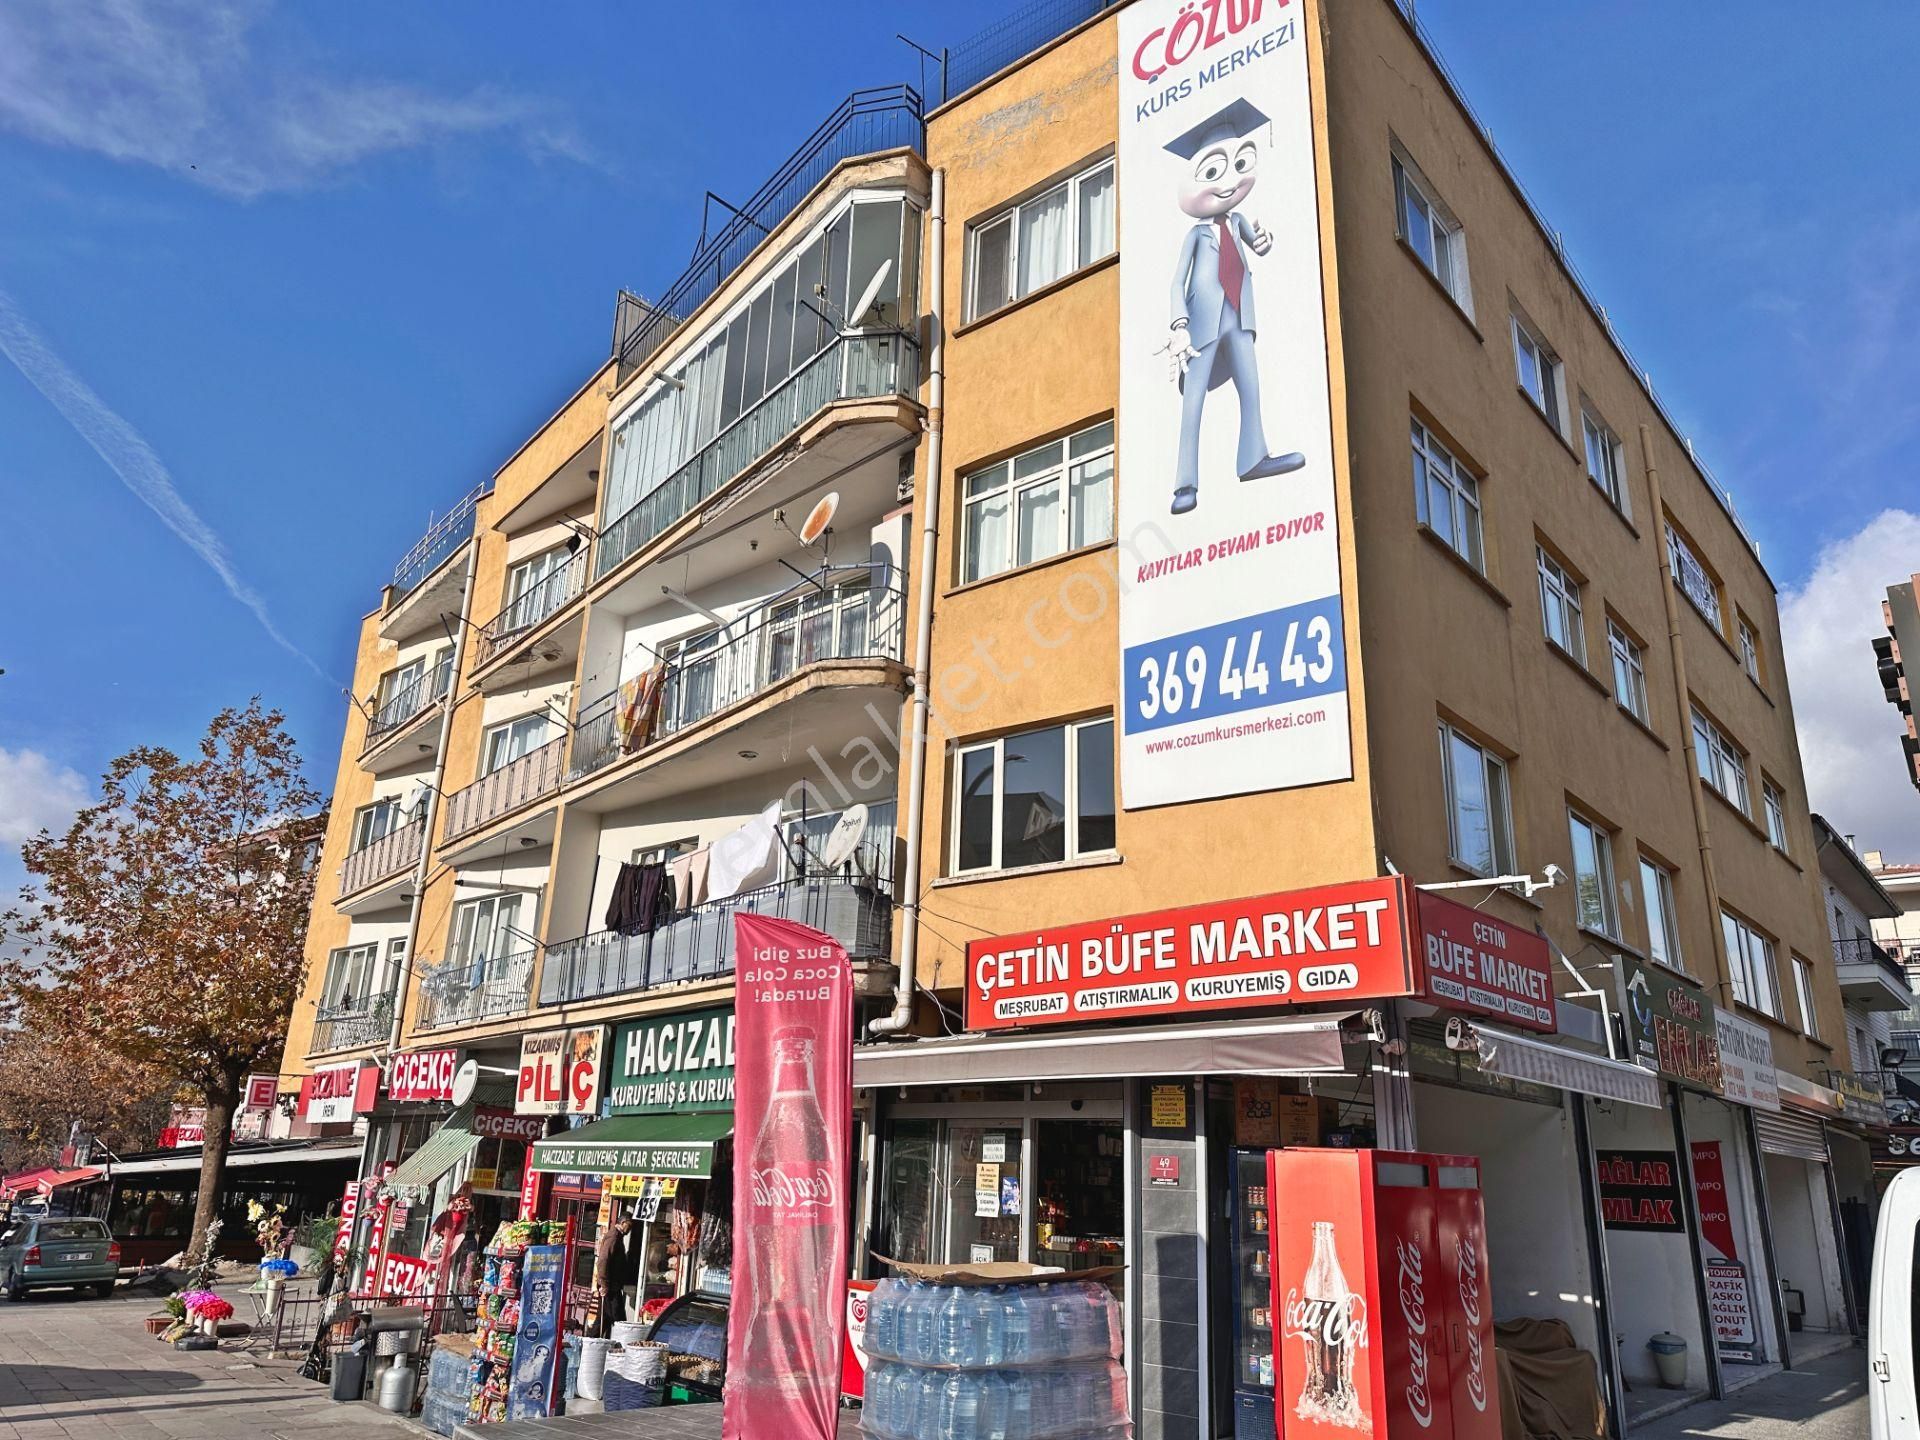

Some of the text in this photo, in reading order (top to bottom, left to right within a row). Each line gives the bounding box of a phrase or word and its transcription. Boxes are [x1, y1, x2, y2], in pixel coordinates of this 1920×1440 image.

[1136, 18, 1295, 123] KURS MERKEZİ
[1136, 547, 1203, 583] KAYITLAR
[1207, 529, 1260, 563] DEVAM
[1139, 615, 1334, 720] 369 44 43
[1145, 709, 1327, 755] www.cozumkursmerkezi.com
[976, 898, 1389, 1000] ÇETİN BÜFE MARKET
[1472, 921, 1507, 950] ÇETİN
[1426, 929, 1548, 1002] BÜFE MARKET
[998, 968, 1351, 1017] MEŞRUBAT ATIŞTIRMALIK KURUYEMİŞ GIDA
[523, 1037, 562, 1056] KIZARMIŞ
[253, 1082, 272, 1103] E
[518, 1053, 594, 1111] PİLİÇ
[610, 1077, 736, 1108] KURUYEMİŞ & KURUK
[540, 1150, 576, 1165] HACIZADE
[620, 1150, 648, 1168] AKTAR
[650, 1150, 701, 1171] ŞEKERLEME
[1159, 1157, 1171, 1168] 49
[1599, 1156, 1672, 1186] AĞLAR
[1601, 1197, 1676, 1225] MLAK
[1712, 1292, 1743, 1302] ASKO
[1712, 1302, 1748, 1314] AĞLIK
[1395, 1232, 1432, 1429] Coca-Cola
[1455, 1232, 1487, 1412] Coca-Cola
[1714, 1314, 1748, 1325] ONUT
